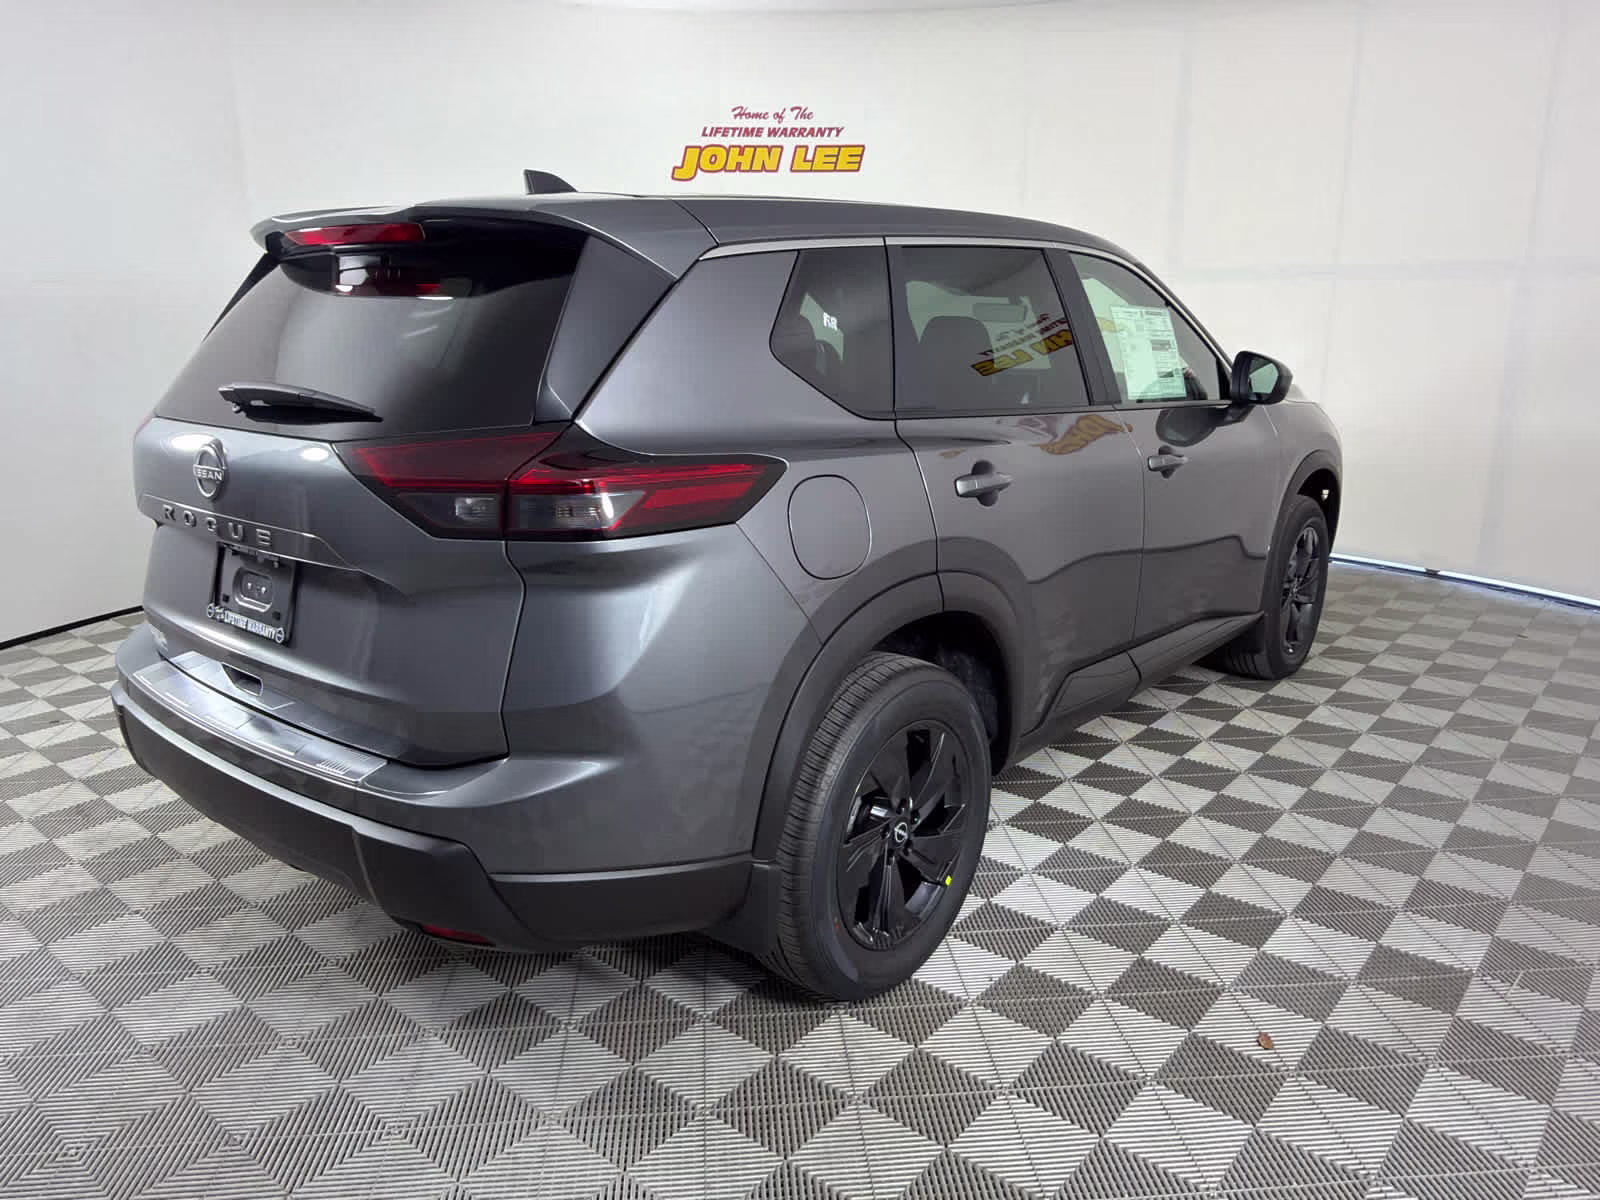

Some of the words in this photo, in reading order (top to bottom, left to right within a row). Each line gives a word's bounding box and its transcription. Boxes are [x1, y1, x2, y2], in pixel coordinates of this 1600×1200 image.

[731, 105, 769, 120] Home
[773, 107, 786, 124] of
[790, 106, 814, 120] The
[701, 126, 764, 137] LIFETIME
[767, 126, 844, 138] WARRANTY
[671, 144, 784, 181] JOHN
[790, 145, 865, 173] LEE
[162, 503, 273, 547] ROGUE
